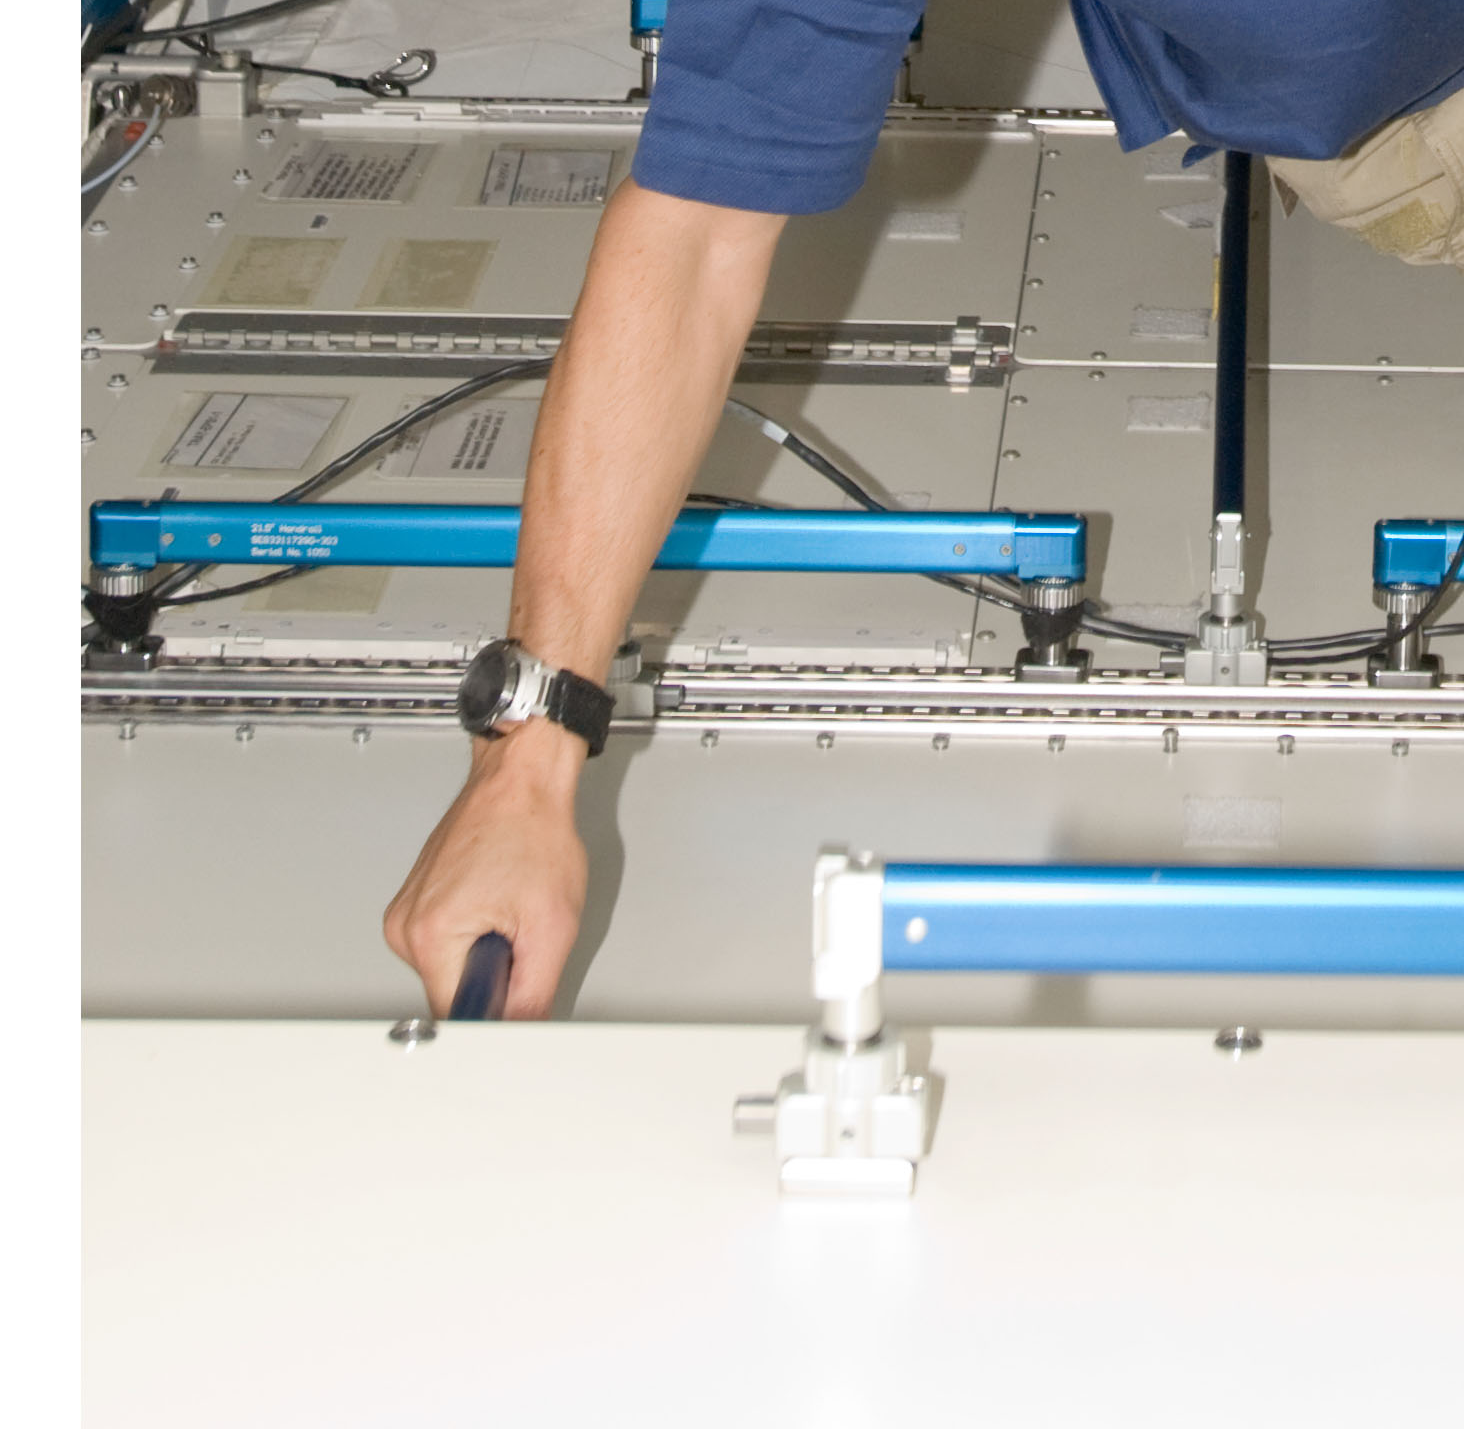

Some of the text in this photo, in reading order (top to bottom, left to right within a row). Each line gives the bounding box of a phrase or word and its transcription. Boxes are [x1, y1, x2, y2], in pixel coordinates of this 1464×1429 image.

[278, 524, 323, 535] Handrail
[250, 546, 283, 558] Serial
[286, 546, 303, 558] No.
